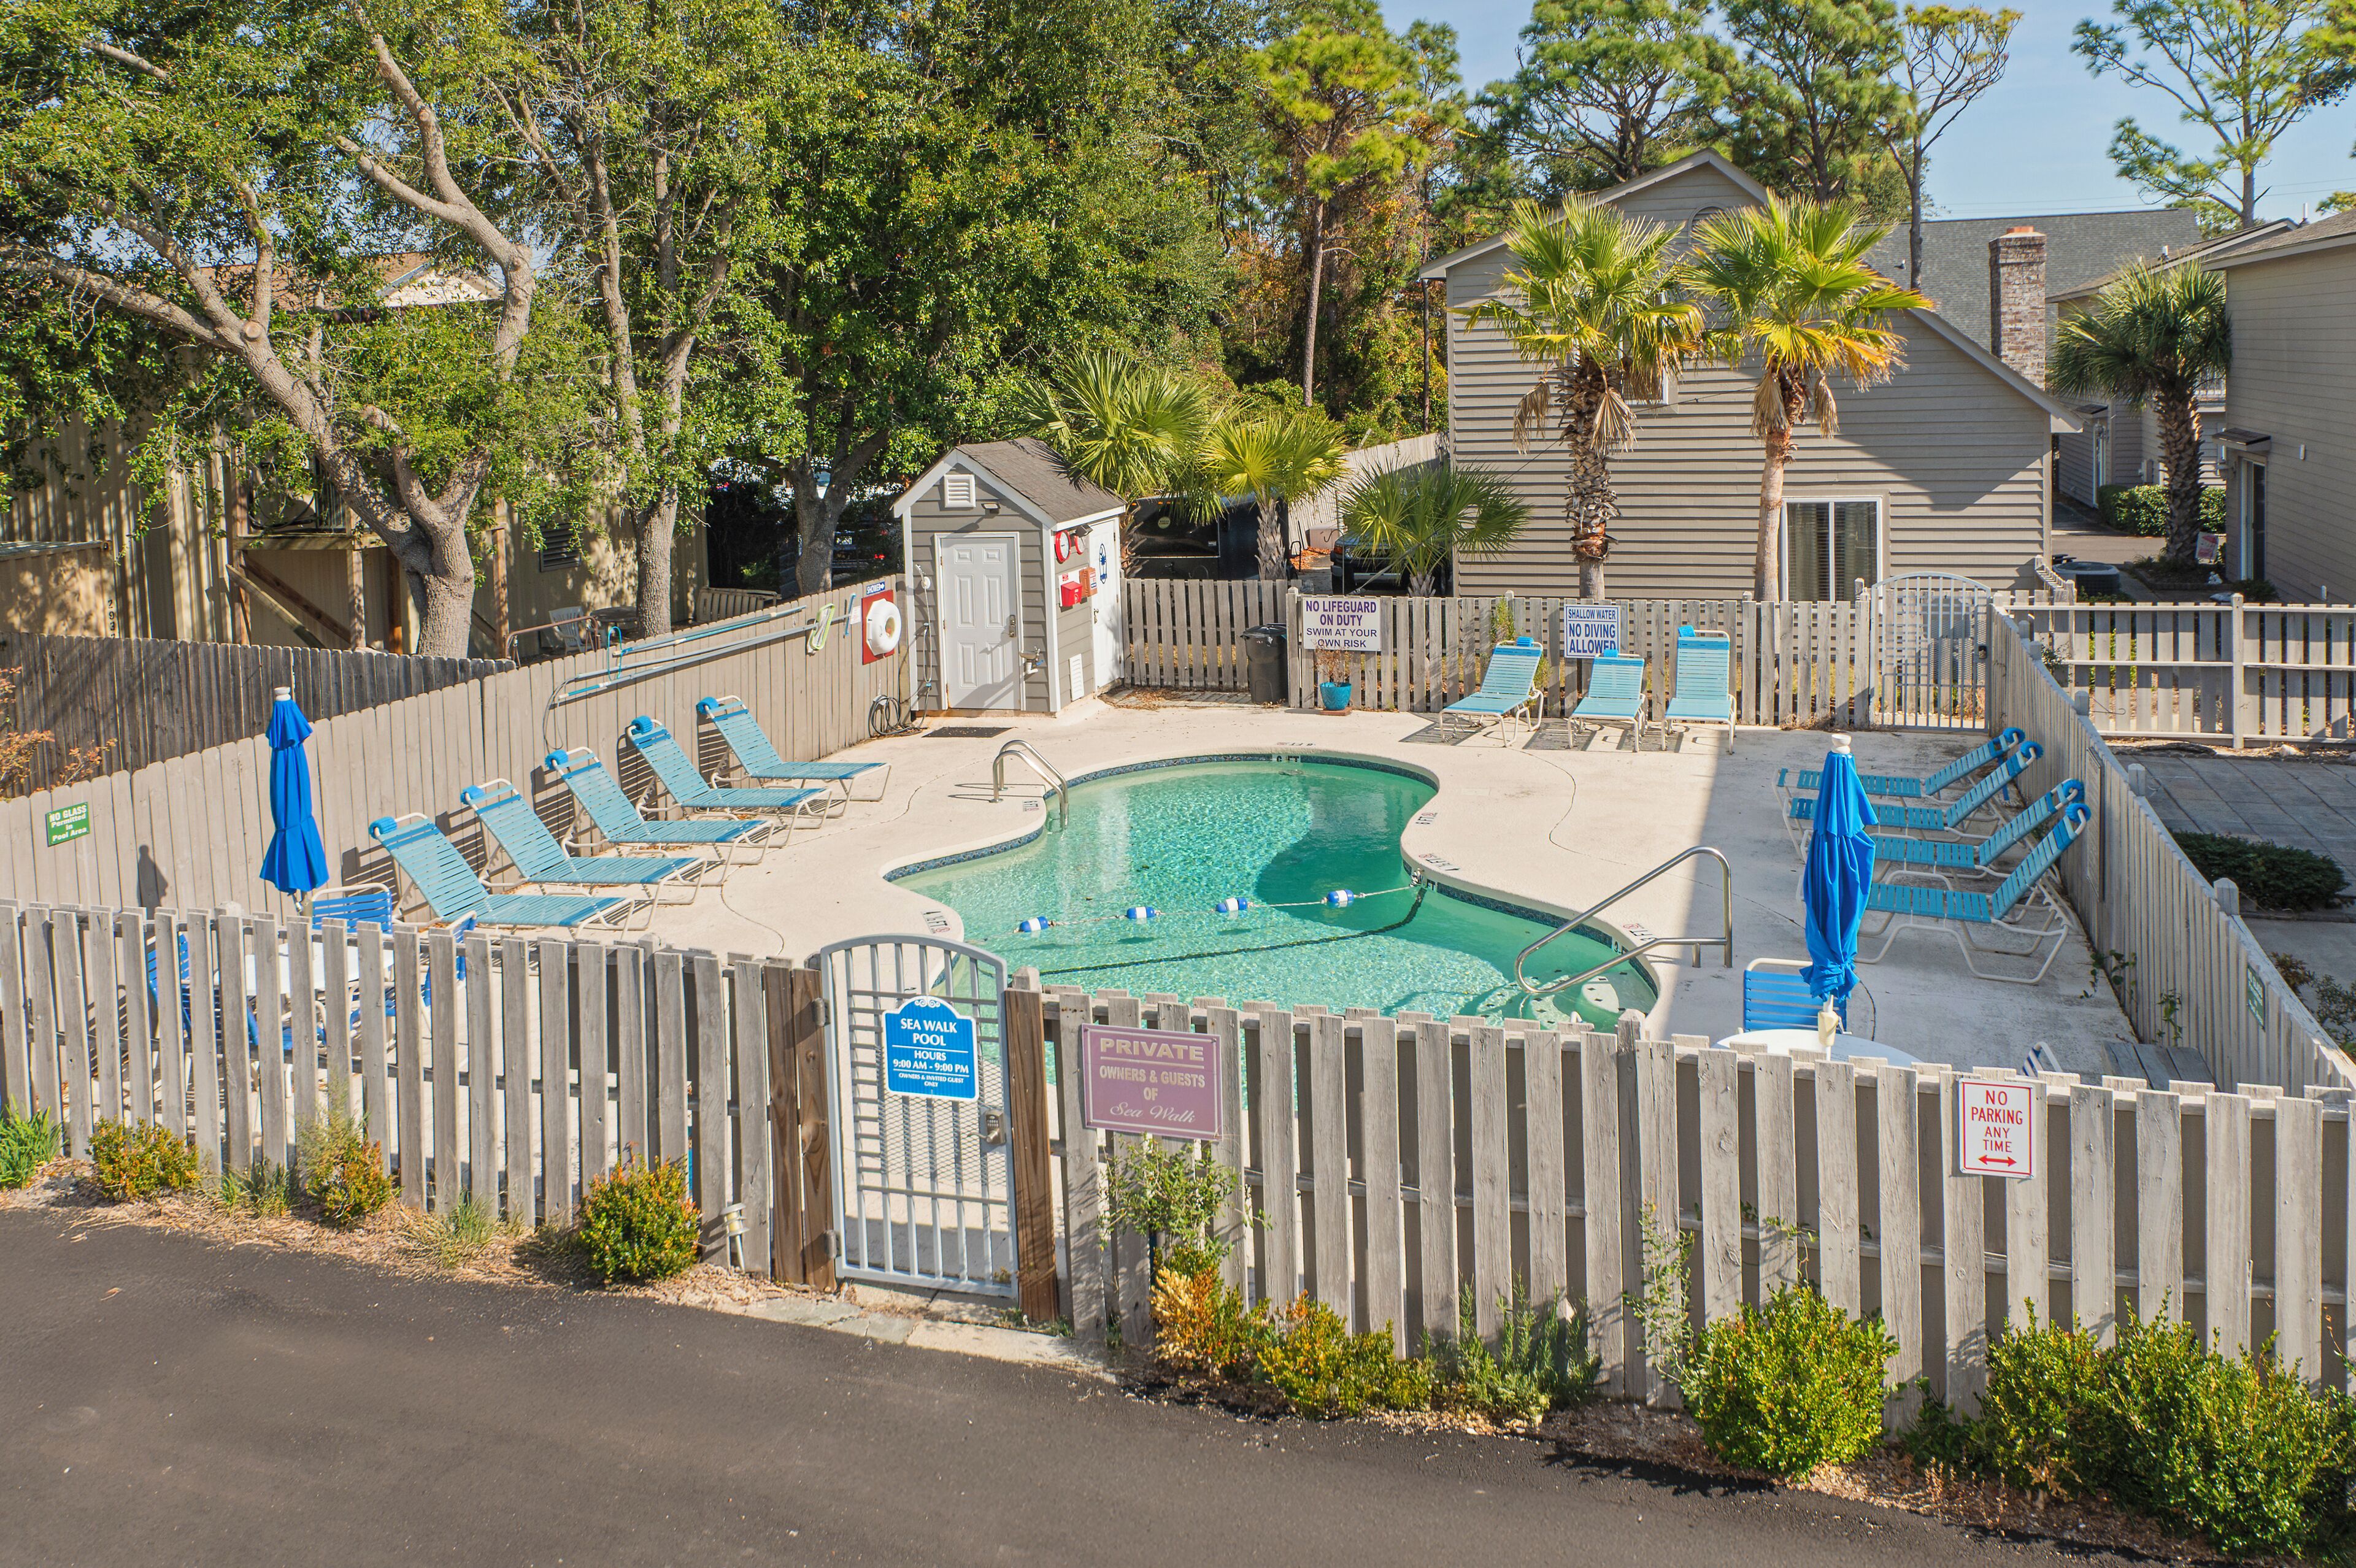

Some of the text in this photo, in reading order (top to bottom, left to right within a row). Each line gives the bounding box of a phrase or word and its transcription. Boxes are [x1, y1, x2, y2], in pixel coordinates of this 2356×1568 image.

[867, 583, 880, 594] SHOWER
[1306, 601, 1377, 613] NO LIFEGUARD
[1320, 614, 1363, 626] ON DUTY
[1568, 609, 1616, 620] SHALLOW WATER
[1306, 628, 1332, 636] SWIM
[1350, 629, 1377, 637] YOUR
[1569, 623, 1615, 638] NO DIVING
[1317, 639, 1341, 647] OWN
[49, 805, 87, 822] NO GLASS
[51, 813, 86, 828] Permitted
[52, 827, 87, 842] Pool Area
[901, 1018, 957, 1033] SEA WALK
[913, 1033, 946, 1046] POOL
[914, 1050, 946, 1061] HOURS
[1100, 1038, 1204, 1061] PRIVATE
[893, 1059, 911, 1068] 9:00
[913, 1061, 927, 1070] AM
[934, 1063, 953, 1072] 9:00
[955, 1064, 969, 1074] PM
[1099, 1065, 1206, 1088] OWNERS & GUESTS
[1144, 1087, 1158, 1101] OF
[1986, 1090, 2008, 1105] NO
[1110, 1102, 1195, 1123] Sea Walk
[1971, 1107, 2023, 1125] PARKING
[1985, 1126, 2010, 1139] ANY
[1983, 1139, 2012, 1153] TIME
